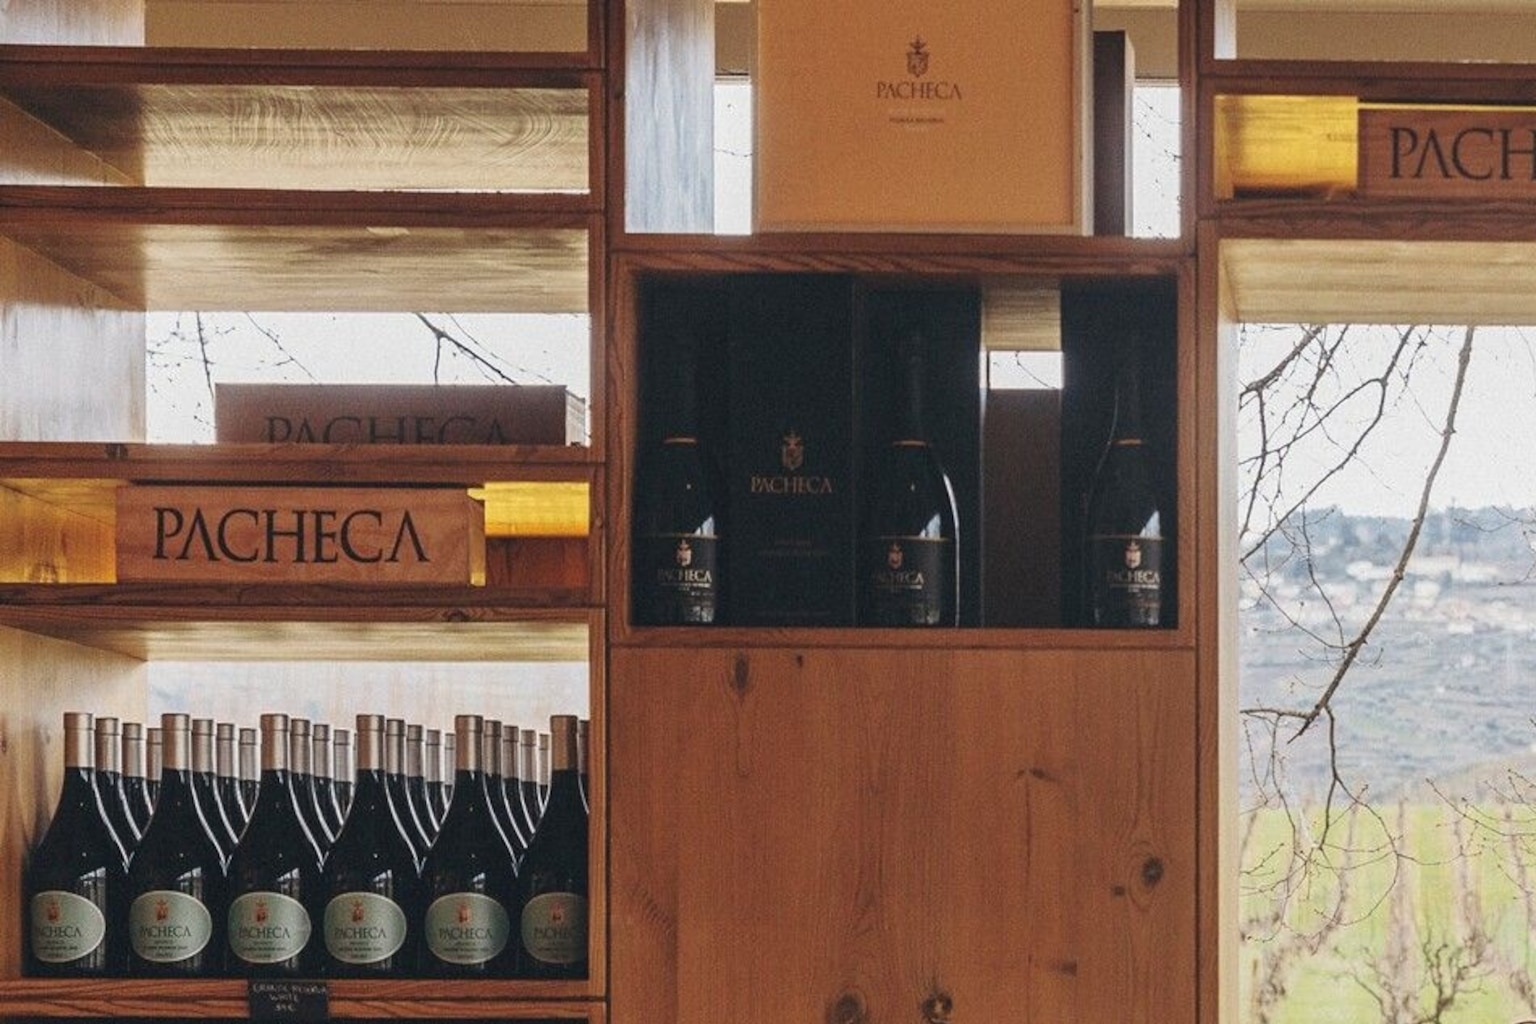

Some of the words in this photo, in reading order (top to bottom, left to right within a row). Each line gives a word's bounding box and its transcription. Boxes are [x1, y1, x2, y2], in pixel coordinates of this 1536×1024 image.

[877, 81, 962, 100] PACHECA
[750, 475, 832, 494] PACHECA
[153, 506, 430, 563] PACHECA
[238, 926, 290, 939] PACHECA
[334, 927, 387, 939] PACHECA
[439, 927, 493, 939] PACHECA
